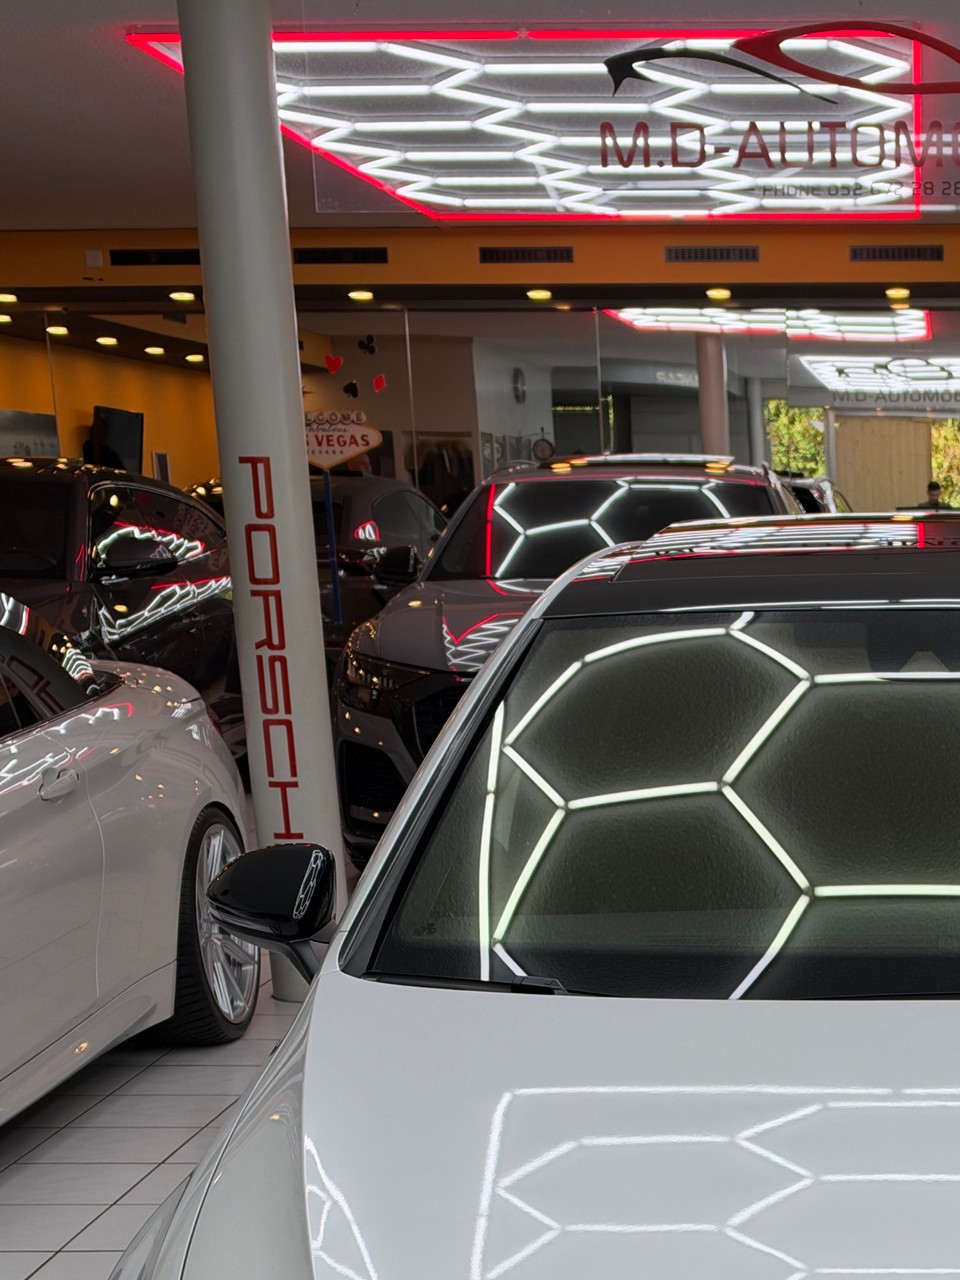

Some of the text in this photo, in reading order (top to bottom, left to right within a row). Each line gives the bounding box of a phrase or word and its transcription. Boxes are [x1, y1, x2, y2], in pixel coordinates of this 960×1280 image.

[826, 182, 863, 196] 052
[911, 181, 934, 196] 28
[305, 411, 363, 422] LCOME
[314, 434, 370, 447] VEGAS
[238, 456, 304, 840] PORSCH
